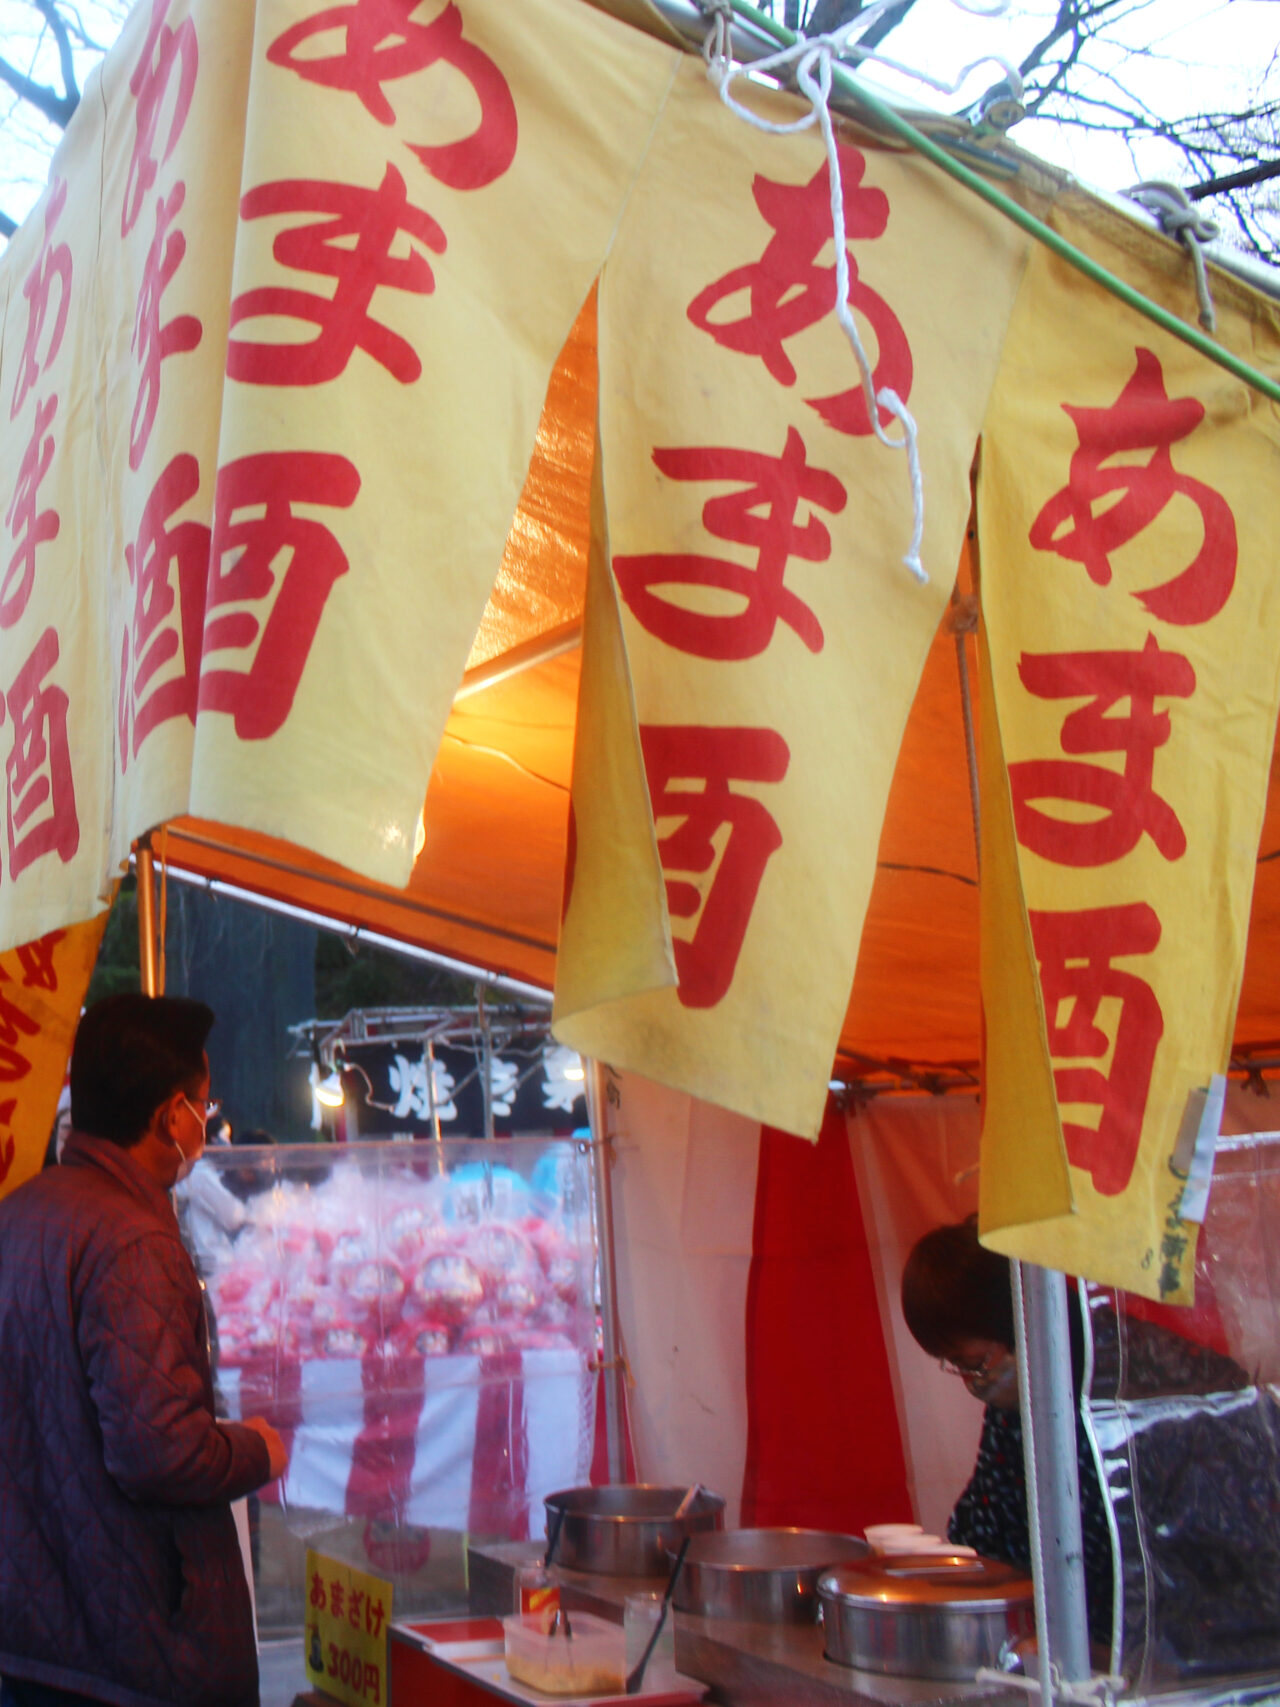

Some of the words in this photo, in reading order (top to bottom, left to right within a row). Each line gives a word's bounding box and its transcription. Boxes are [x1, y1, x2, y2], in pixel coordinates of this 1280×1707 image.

[119, 0, 212, 776] あま酒
[196, 0, 518, 741] あま酒
[612, 144, 913, 1010] あま酒
[1007, 346, 1238, 1197] あま酒
[309, 1571, 385, 1639] あまざけ
[327, 1642, 381, 1705] 300円
